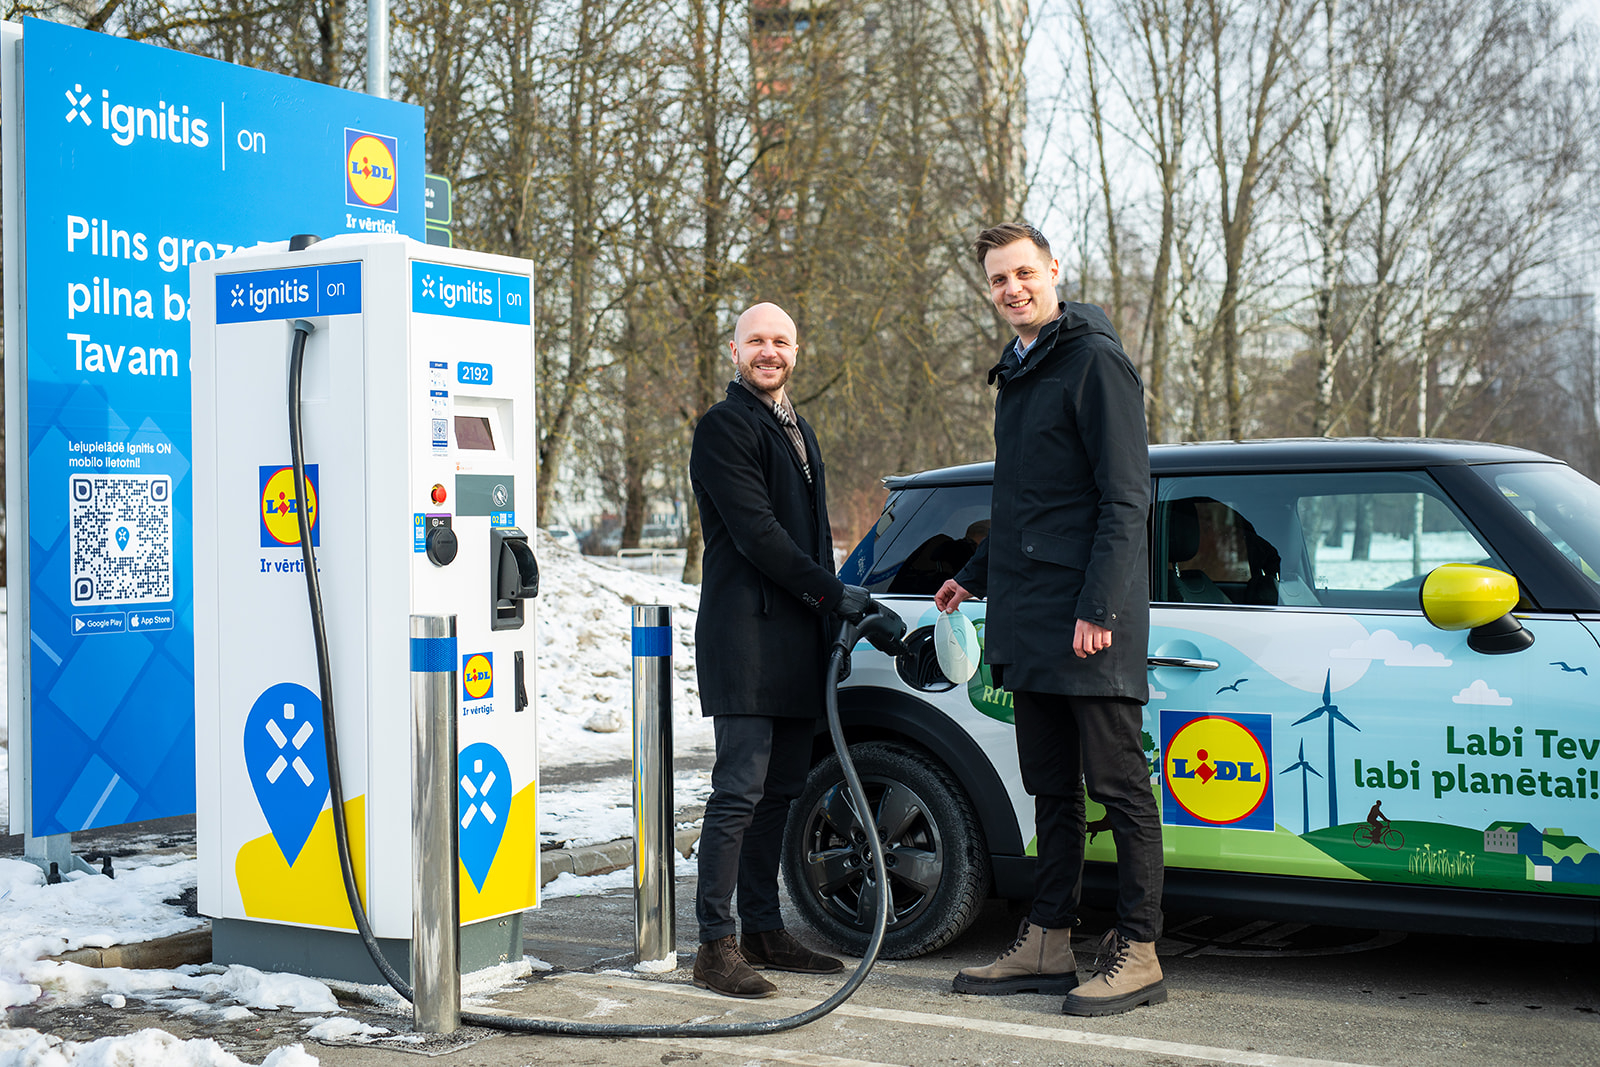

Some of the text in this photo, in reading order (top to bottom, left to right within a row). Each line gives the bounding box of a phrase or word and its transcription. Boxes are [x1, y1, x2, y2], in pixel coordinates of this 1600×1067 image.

[102, 89, 266, 154] ignitis on
[346, 213, 357, 228] Ir
[67, 215, 148, 261] Pilns
[68, 276, 154, 319] pilna
[249, 278, 345, 313] ignitis on
[439, 276, 522, 308] ignitis on
[67, 333, 178, 377] Tavam
[462, 366, 489, 381] 2192
[126, 442, 155, 455] Ignitis
[155, 443, 172, 454] ON
[68, 456, 141, 468] mobilo lietotni!
[415, 515, 424, 525] 01
[491, 515, 500, 524] 02
[260, 558, 271, 573] Ir
[86, 618, 122, 629] Google Play
[141, 615, 171, 626] App Store
[463, 703, 495, 716] Ir vērtīgi.
[1446, 725, 1600, 760] Labi Tev
[1354, 759, 1600, 800] labi planētai!
